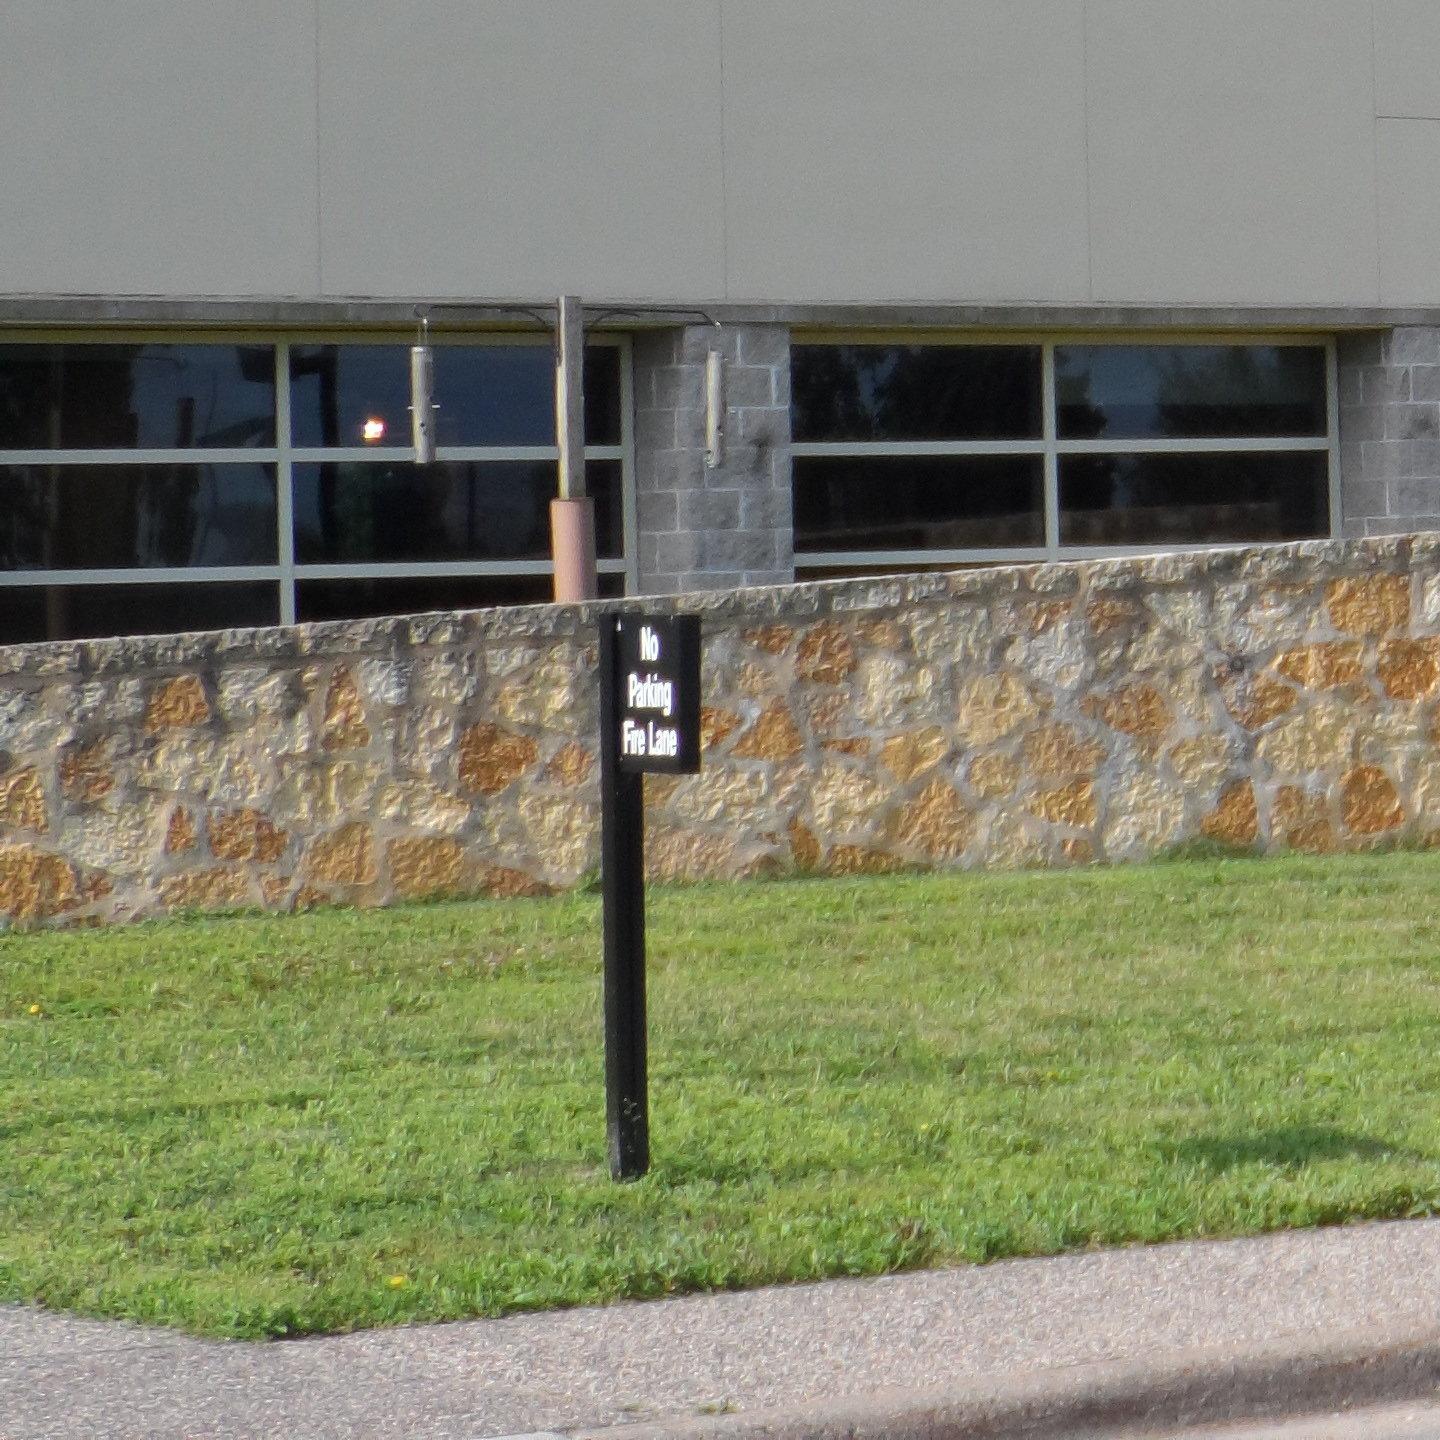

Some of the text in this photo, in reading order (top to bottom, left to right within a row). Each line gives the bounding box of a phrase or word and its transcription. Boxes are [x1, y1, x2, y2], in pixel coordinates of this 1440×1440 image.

[640, 626, 660, 661] No
[627, 671, 673, 717] Parking
[622, 719, 678, 757] Fire Lane
